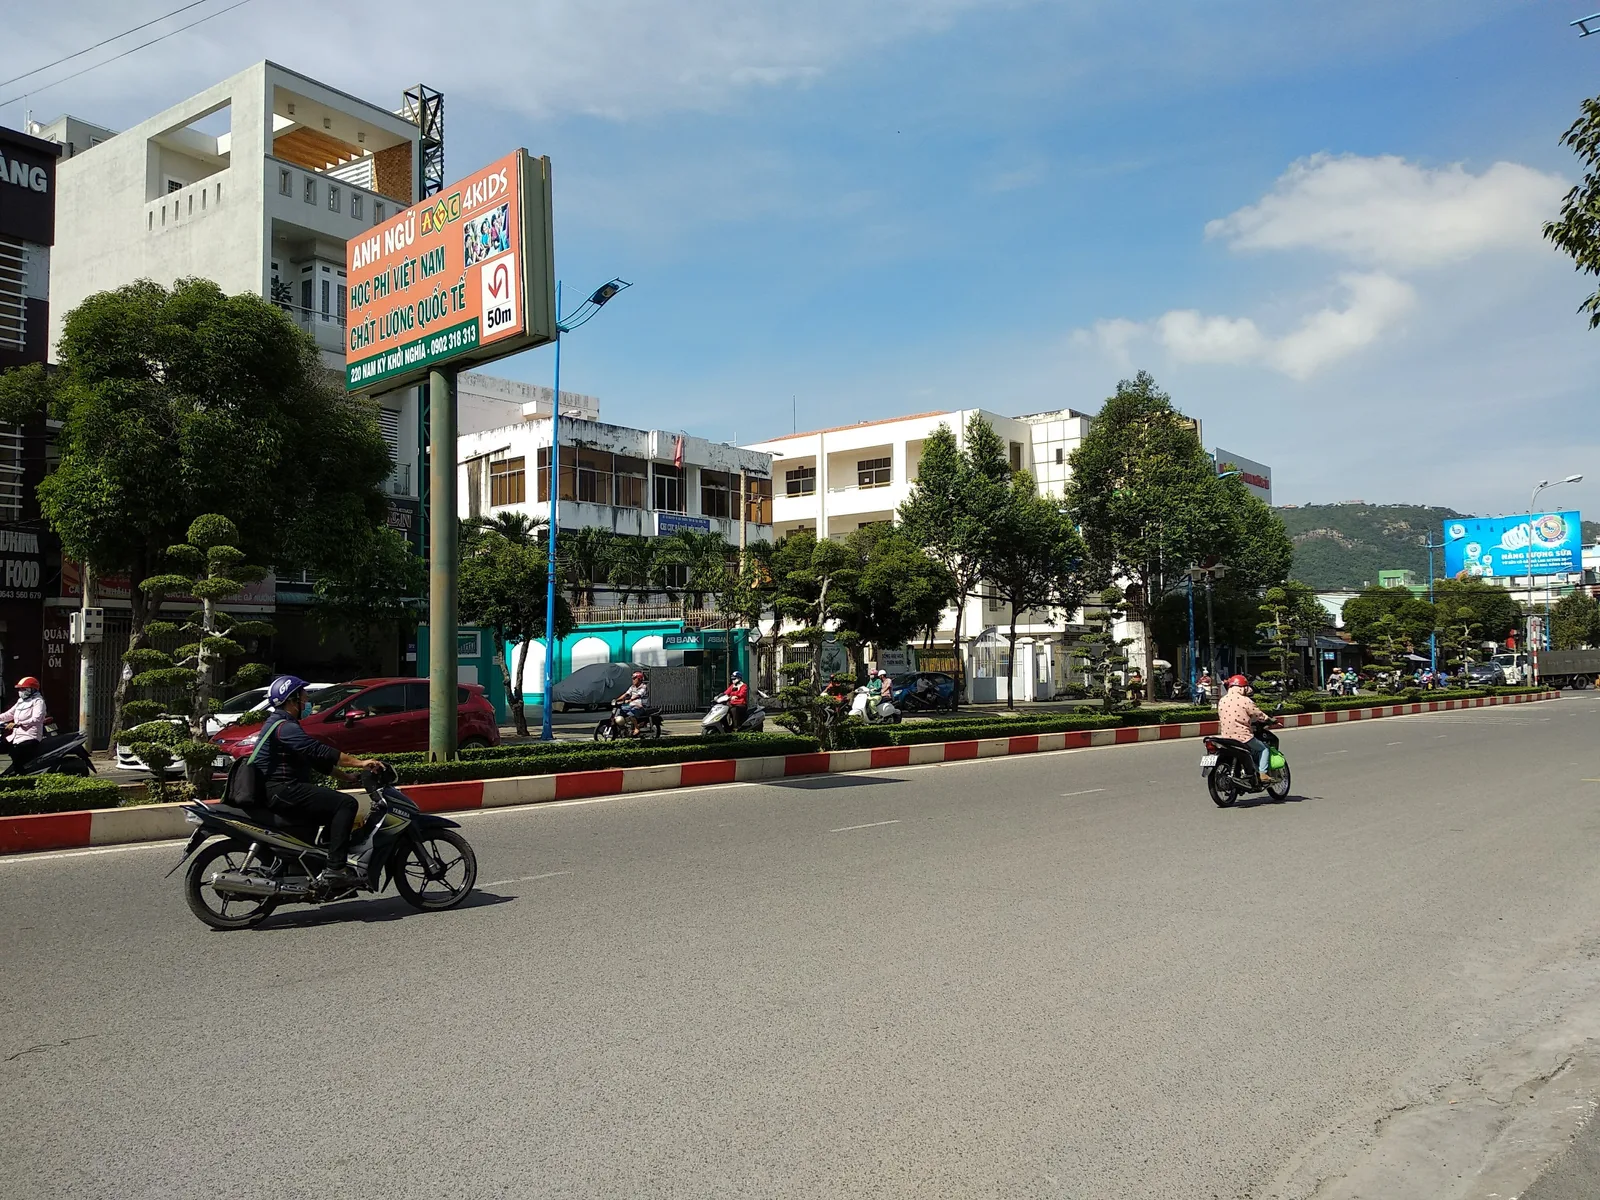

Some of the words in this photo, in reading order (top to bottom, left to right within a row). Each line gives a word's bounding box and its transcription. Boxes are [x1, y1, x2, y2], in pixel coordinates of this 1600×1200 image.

[353, 234, 381, 271] ANH
[384, 210, 416, 256] NGỮ
[421, 193, 460, 235] ABC
[463, 167, 508, 210] 4KIDS
[350, 280, 371, 312] HỌC
[374, 263, 392, 301] PHÍ
[393, 255, 417, 293] VIỆT
[420, 244, 446, 280] NAM
[350, 311, 376, 351] CHẤT
[379, 304, 415, 341] LƯỢNG
[417, 281, 448, 330] QUỐC
[450, 270, 468, 313] TẾ
[487, 307, 512, 329] 50m
[351, 366, 362, 383] 220
[363, 360, 377, 379] NAM
[377, 353, 387, 374] KỲ
[430, 335, 448, 356] 0902
[448, 330, 462, 349] 318
[462, 324, 476, 345] 313
[6, 560, 40, 588] FOOD
[44, 627, 70, 640] QUÁN
[48, 643, 65, 654] HAI
[48, 655, 62, 668] ỐM
[279, 679, 292, 694] GP
